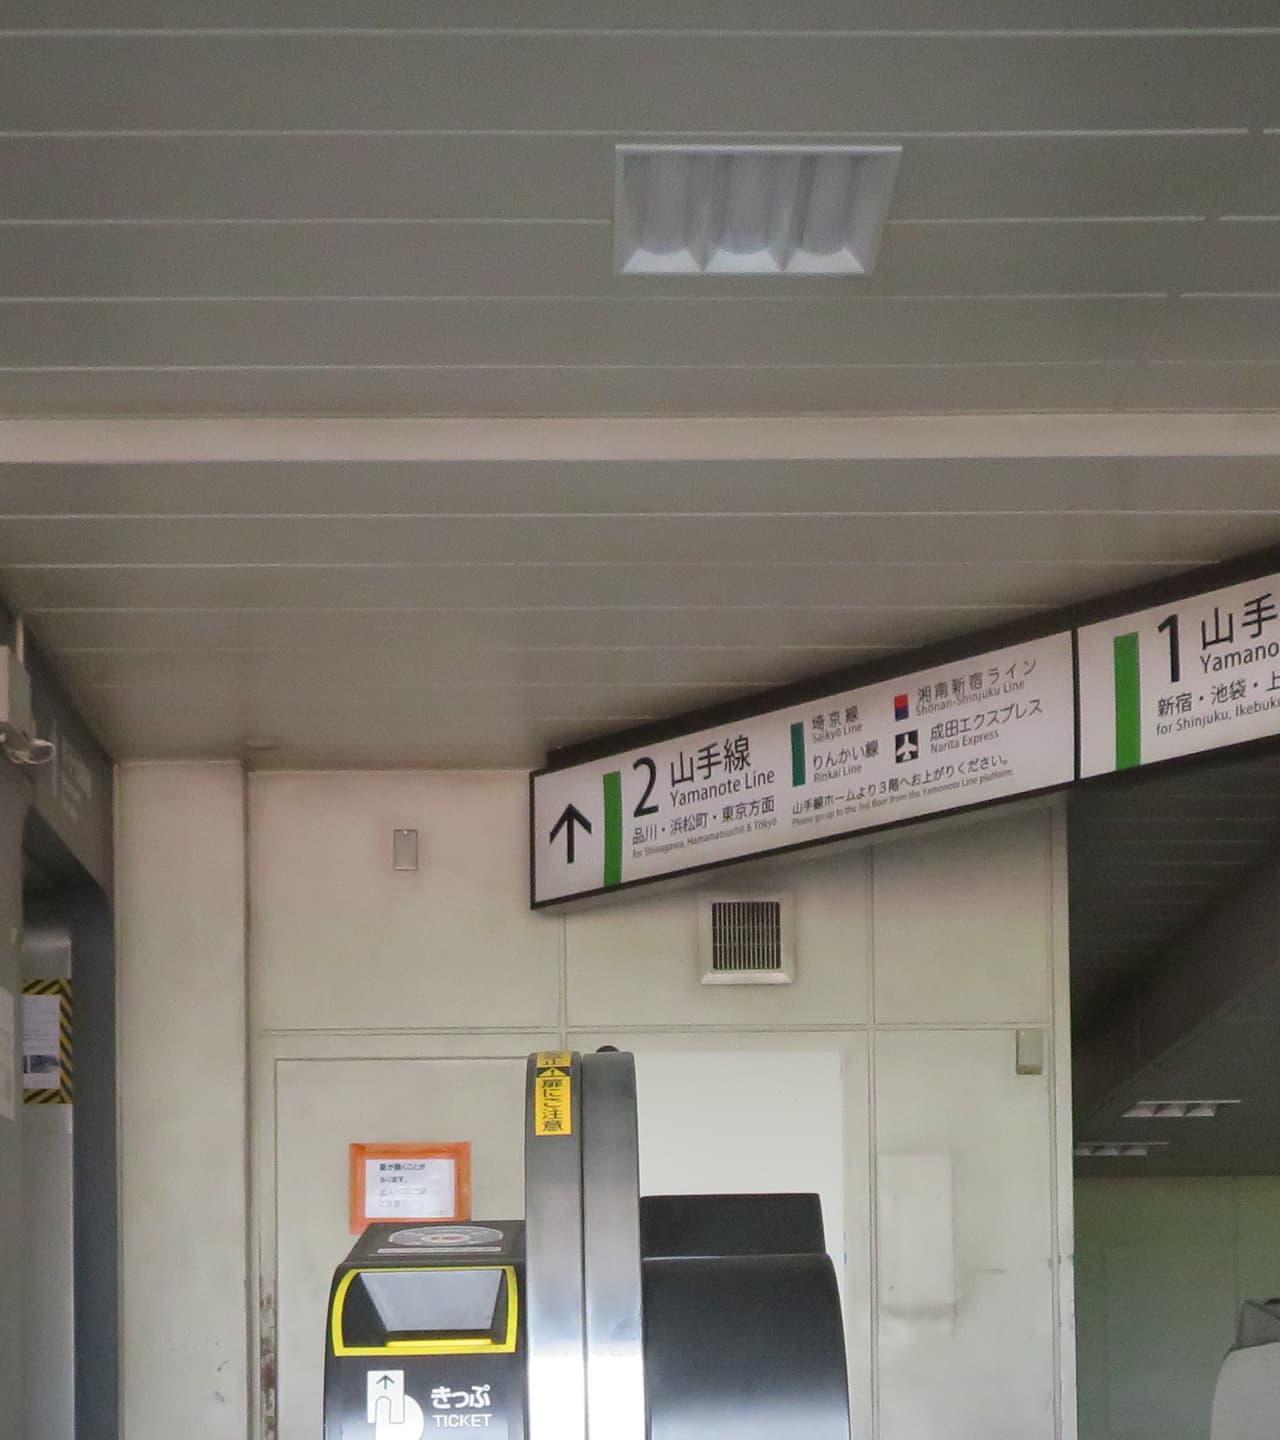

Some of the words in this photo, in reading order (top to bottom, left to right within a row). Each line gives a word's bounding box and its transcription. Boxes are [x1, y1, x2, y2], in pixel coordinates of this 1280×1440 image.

[1157, 613, 1181, 683] 1
[917, 658, 1038, 702] 湘南新宿ライン
[1002, 678, 1026, 695] Line
[811, 704, 860, 732] 埼京線
[843, 721, 863, 737] Line
[929, 699, 1043, 743] 成田エクスプレス
[1156, 721, 1174, 736] for
[1176, 709, 1233, 733] Shinjuku,
[812, 739, 880, 771] りんかい線
[929, 738, 960, 755] Narita
[961, 729, 1000, 750] Express
[670, 734, 753, 788] 山手線
[813, 765, 842, 784] Rinkai
[842, 762, 863, 778] Line
[632, 756, 660, 819] 2
[669, 780, 742, 808] Yamanote
[745, 769, 776, 791] Line
[922, 781, 961, 798] Yamanote
[961, 777, 979, 789] Line
[631, 795, 776, 846] 品川・浜松町・東京方面
[632, 847, 644, 859] for
[430, 1383, 492, 1409] きっぷ
[432, 1413, 493, 1428] TICKET
